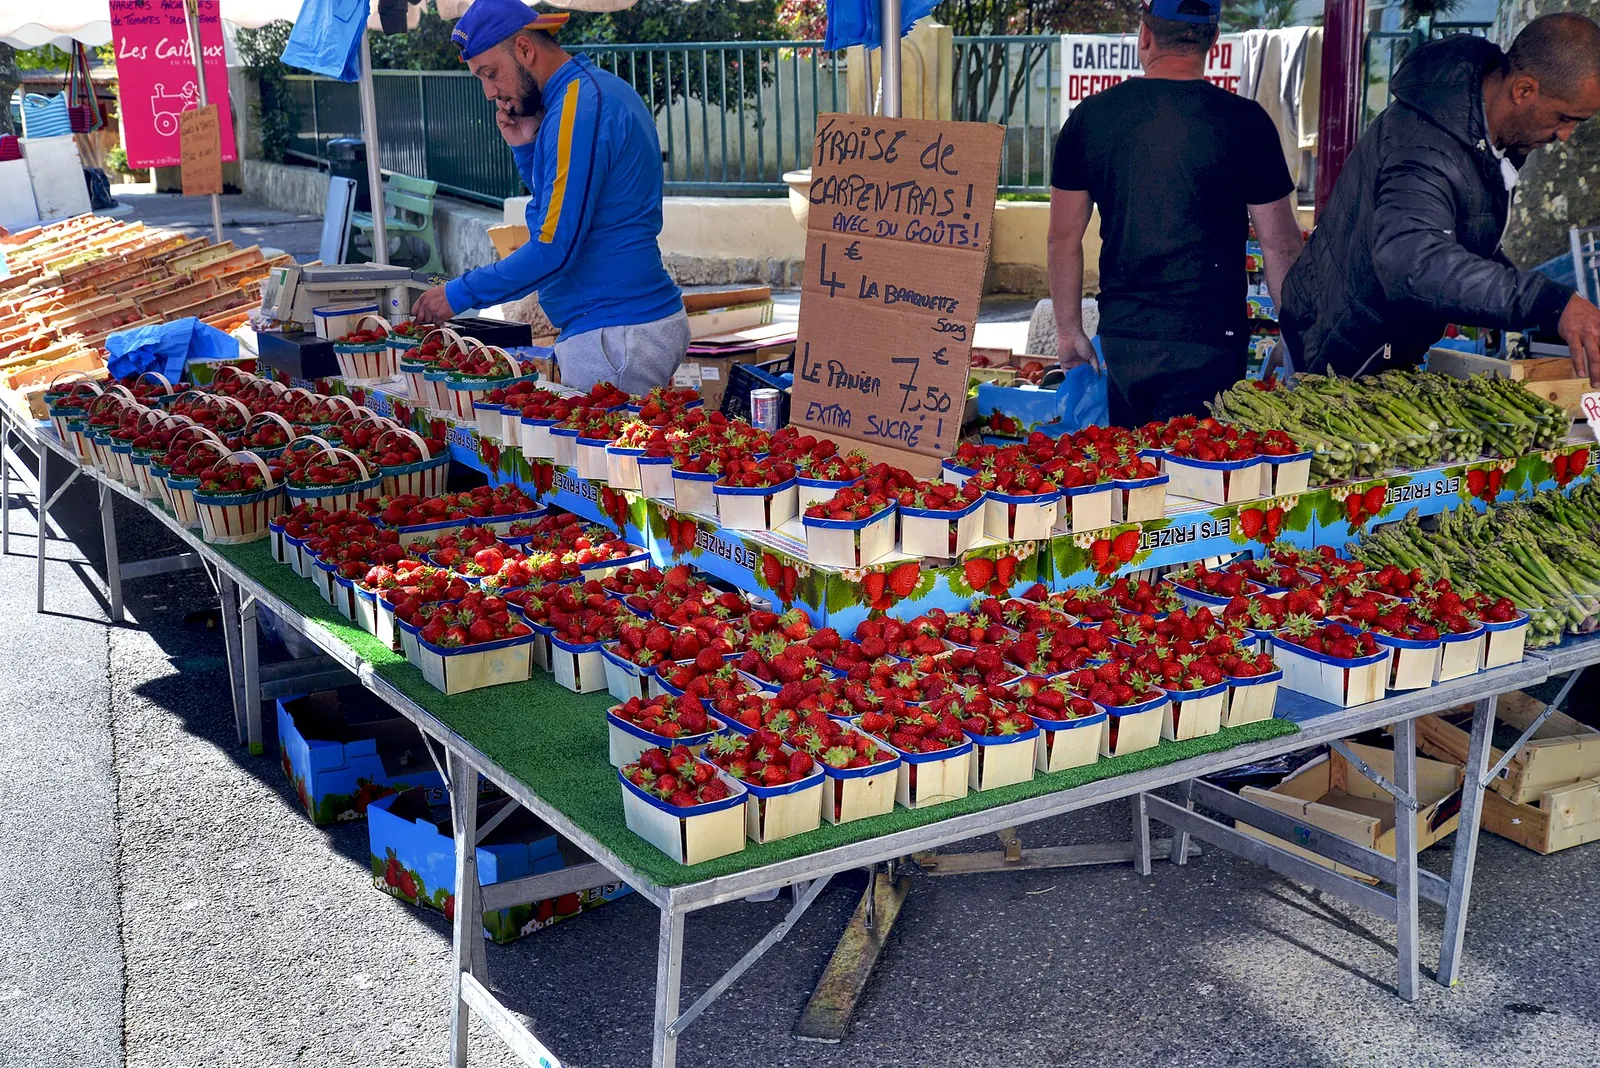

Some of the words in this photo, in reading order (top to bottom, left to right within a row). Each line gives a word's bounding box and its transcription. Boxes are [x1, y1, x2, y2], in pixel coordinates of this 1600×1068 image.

[119, 37, 148, 60] Les
[155, 37, 223, 59] Cailux
[919, 132, 958, 176] de
[833, 211, 870, 233] AVEC
[875, 220, 898, 237] DU
[932, 317, 967, 341] 500g
[806, 402, 852, 428] EXTRA
[552, 470, 580, 496] FRIZET
[581, 482, 598, 503] ETS
[1385, 481, 1431, 505] FRIZET
[1435, 477, 1460, 497] ETS
[1138, 523, 1196, 552] FRIZET
[1200, 517, 1232, 540] ETS
[694, 528, 732, 562] FRIZET
[734, 545, 757, 571] ETS
